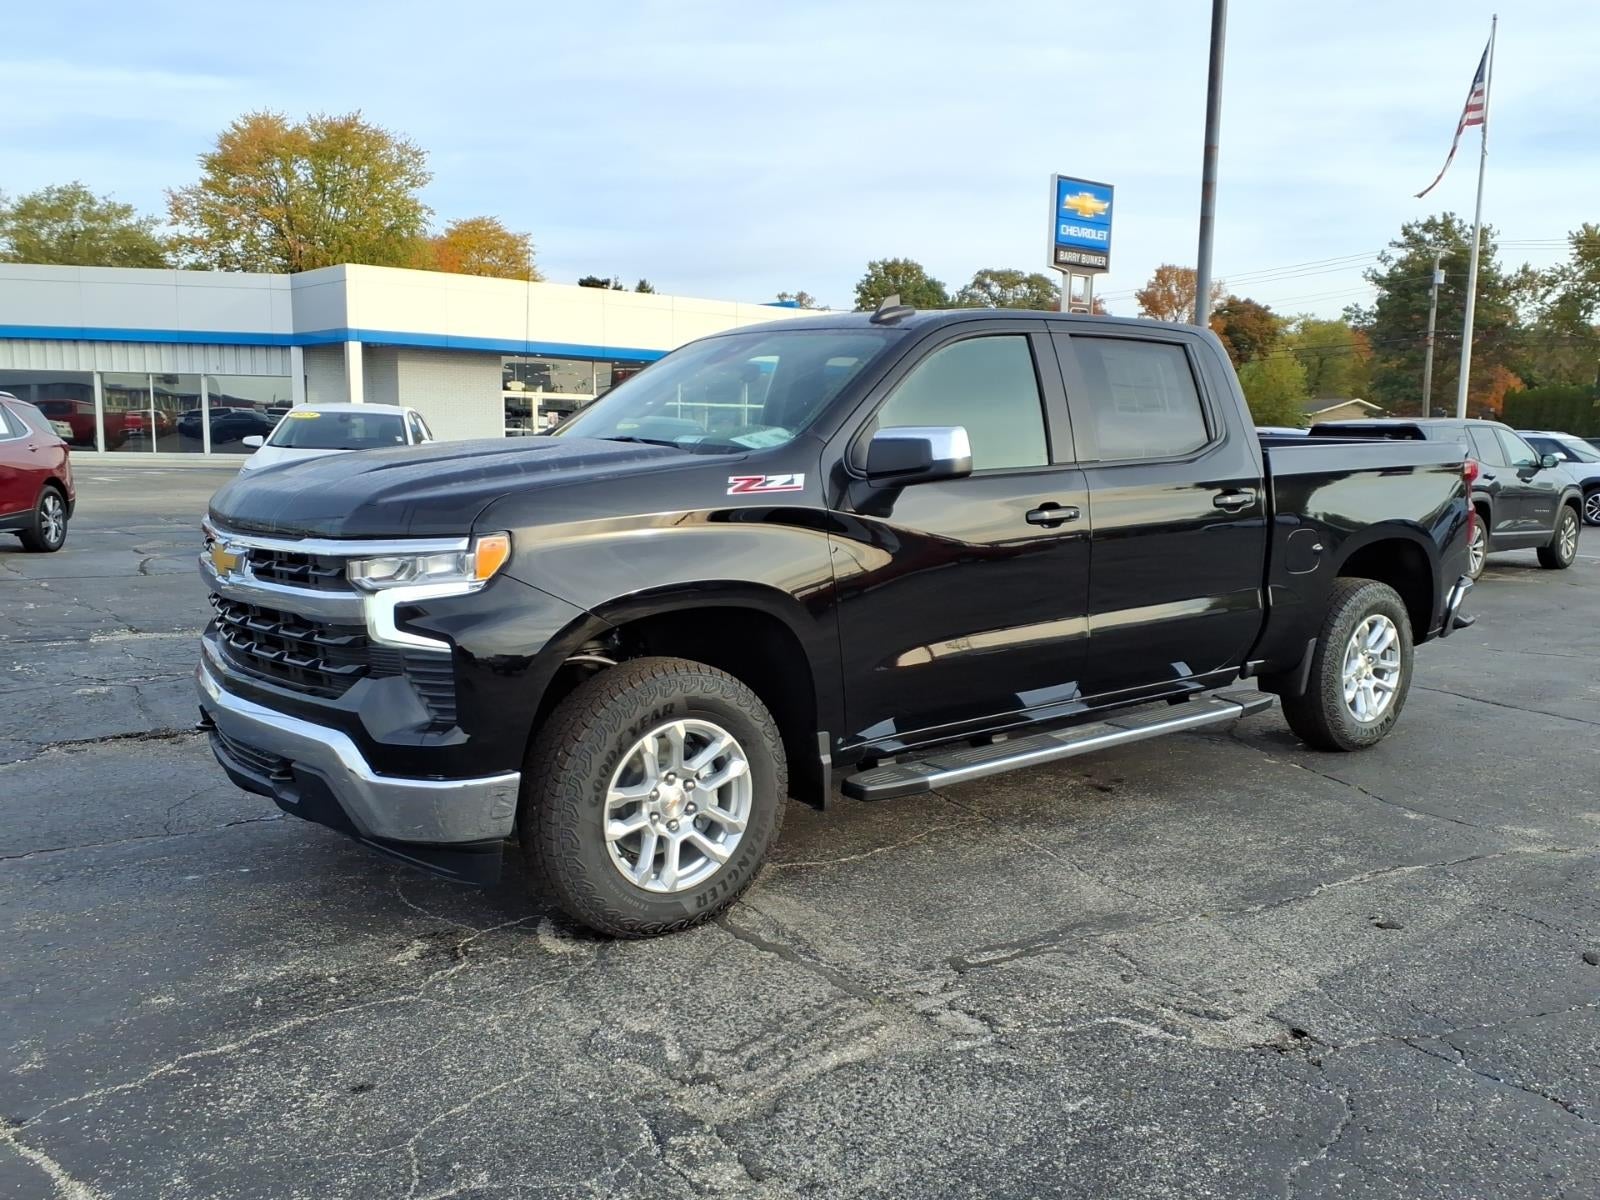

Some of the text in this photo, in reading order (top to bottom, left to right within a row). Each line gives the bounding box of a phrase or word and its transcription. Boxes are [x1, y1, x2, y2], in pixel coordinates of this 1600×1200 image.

[1061, 224, 1108, 241] CHEVROLET
[1060, 250, 1106, 266] BARRY BUNKER
[727, 473, 805, 495] Z71
